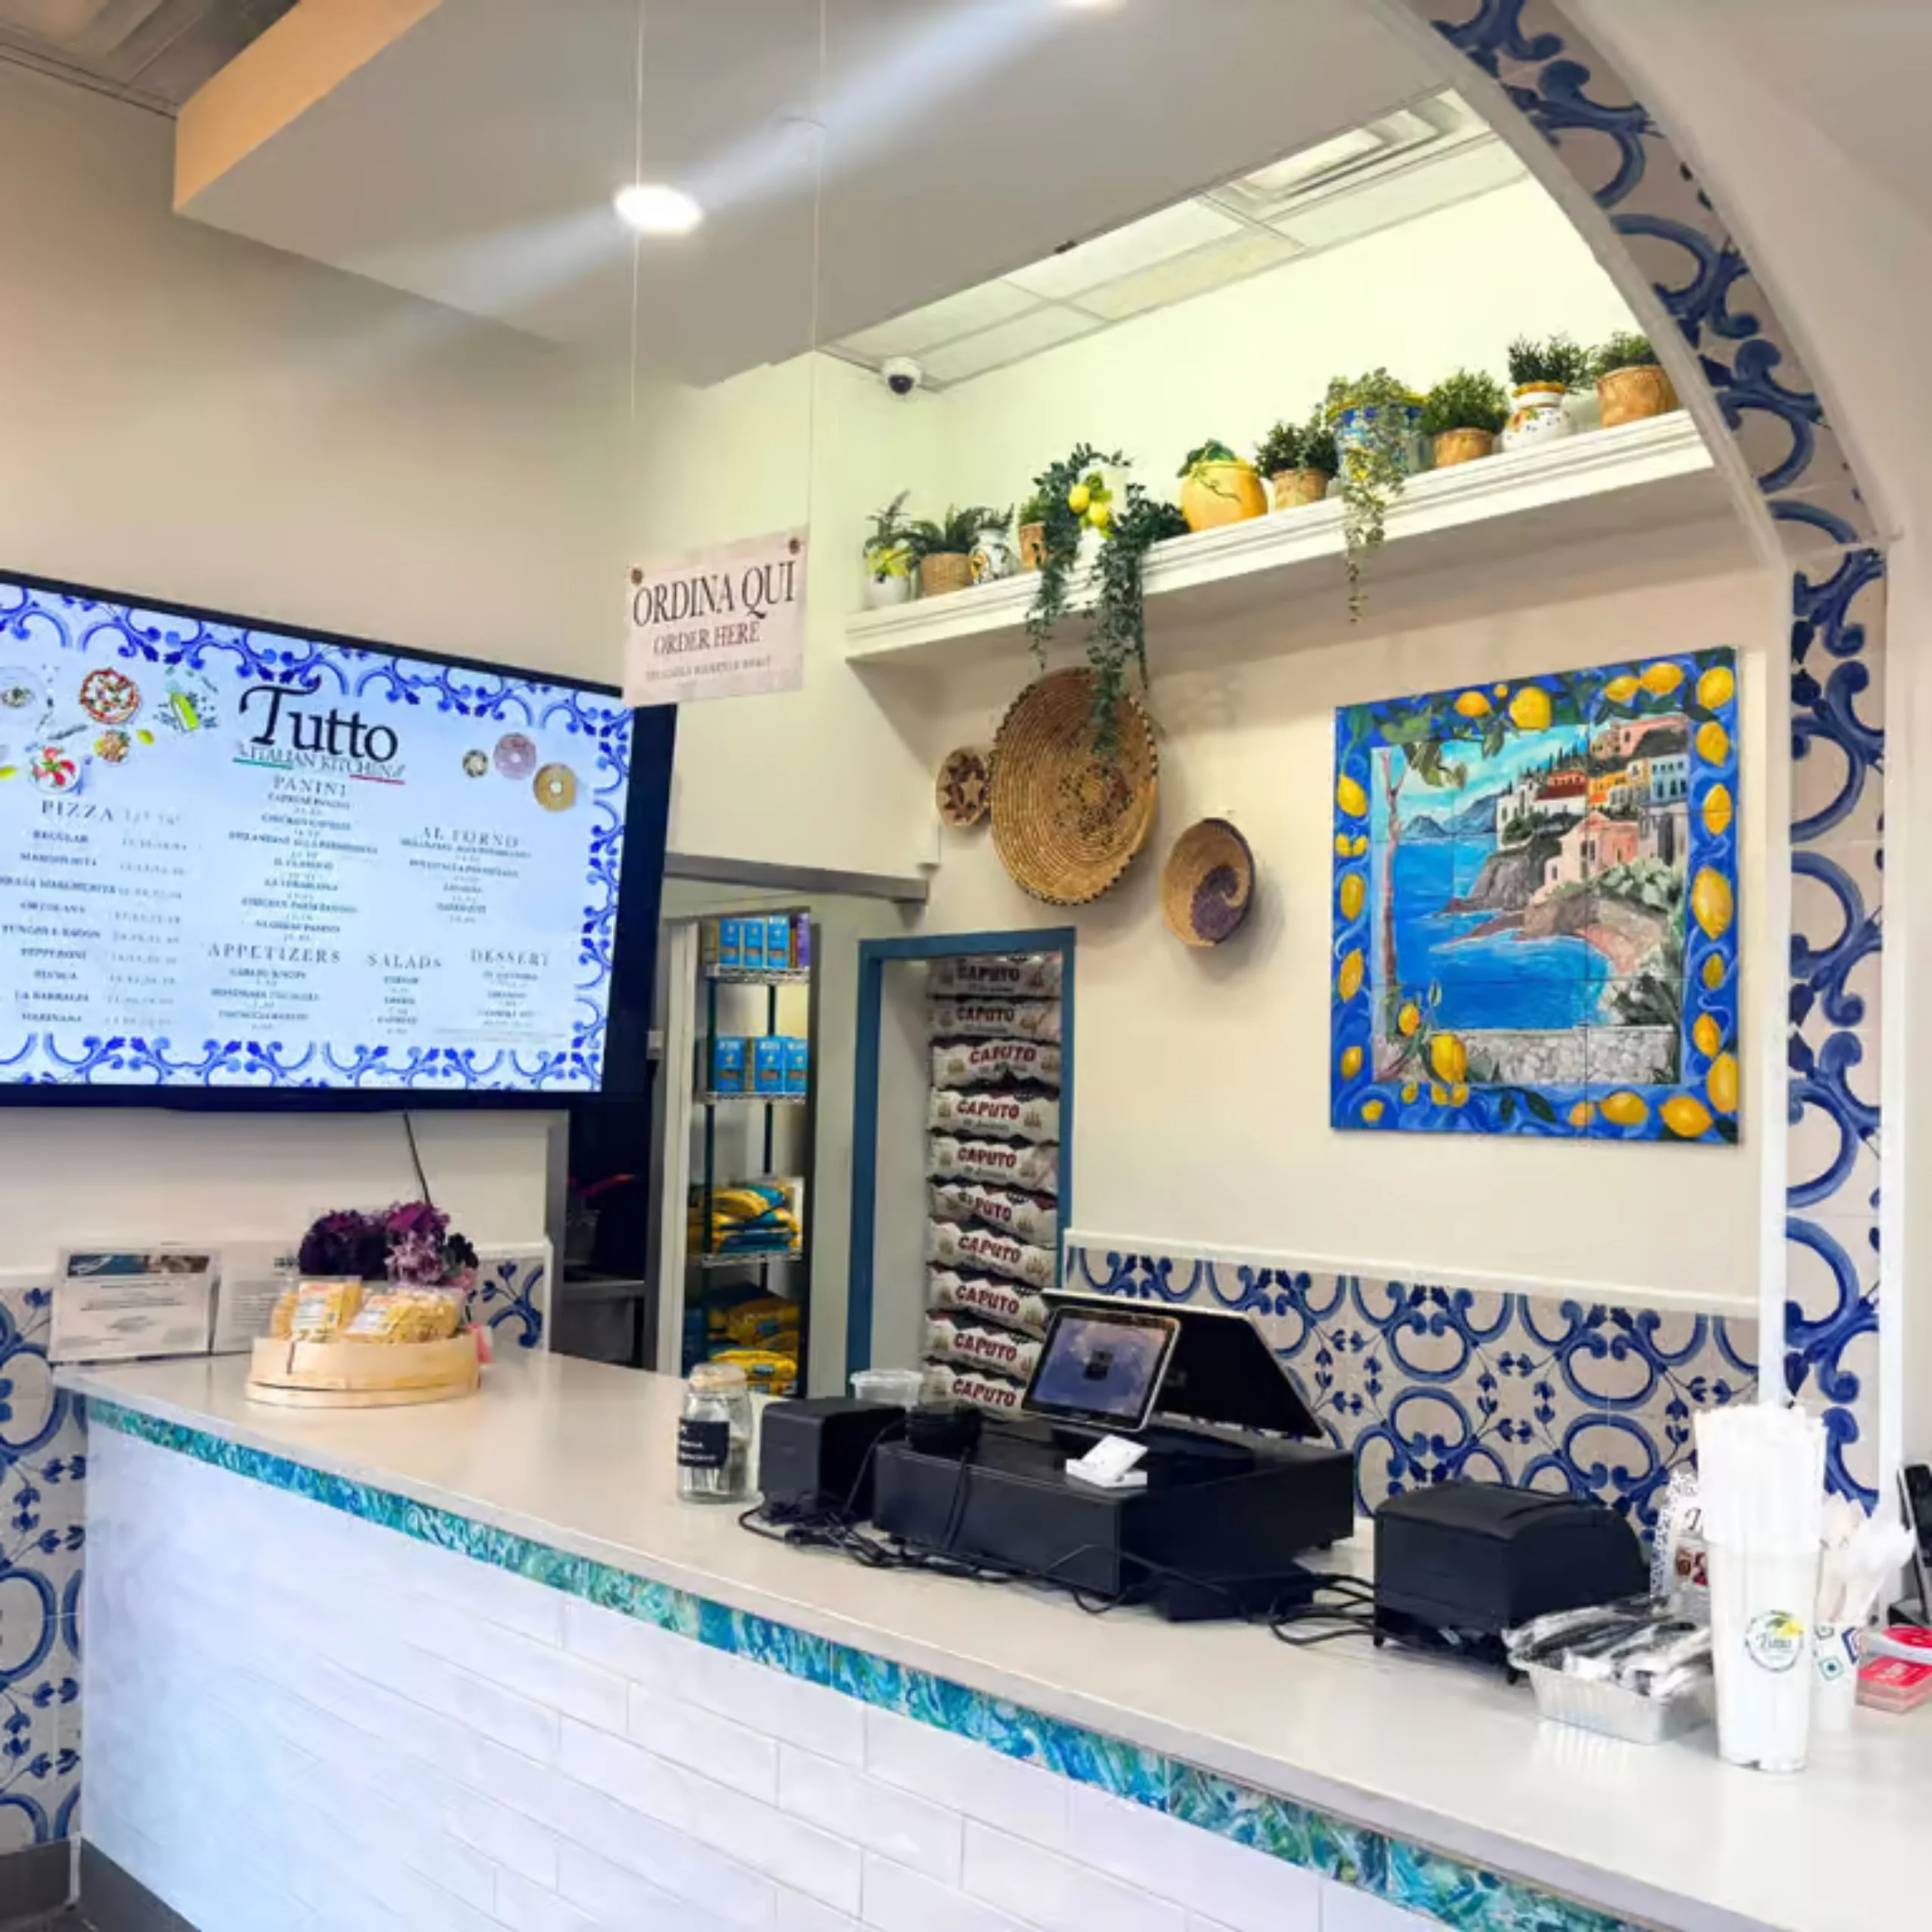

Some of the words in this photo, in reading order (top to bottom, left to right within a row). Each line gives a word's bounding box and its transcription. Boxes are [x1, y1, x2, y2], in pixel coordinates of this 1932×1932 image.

[633, 574, 735, 627] ORDINA
[741, 561, 796, 619] QUI
[653, 629, 710, 655] ORDER
[714, 621, 760, 648] HERE
[239, 674, 398, 762] Tutto
[274, 774, 346, 797] PANINI
[42, 799, 114, 822] PIZZA
[208, 943, 341, 964] APPETIZERS
[367, 952, 442, 970] SALADS
[470, 949, 549, 967] DESSERT
[957, 965, 1020, 983] CAPUTO
[957, 1006, 1014, 1023] CAPUTO
[970, 1046, 1036, 1064] CAPUTO
[957, 1100, 1020, 1120] CAPUTO
[958, 1146, 1017, 1168] CAPUTO
[958, 1234, 1022, 1264] CAPUTO
[955, 1284, 1020, 1315] CAPUTO
[954, 1333, 1017, 1362] CAPUTO
[952, 1378, 1017, 1408] CAPUTO
